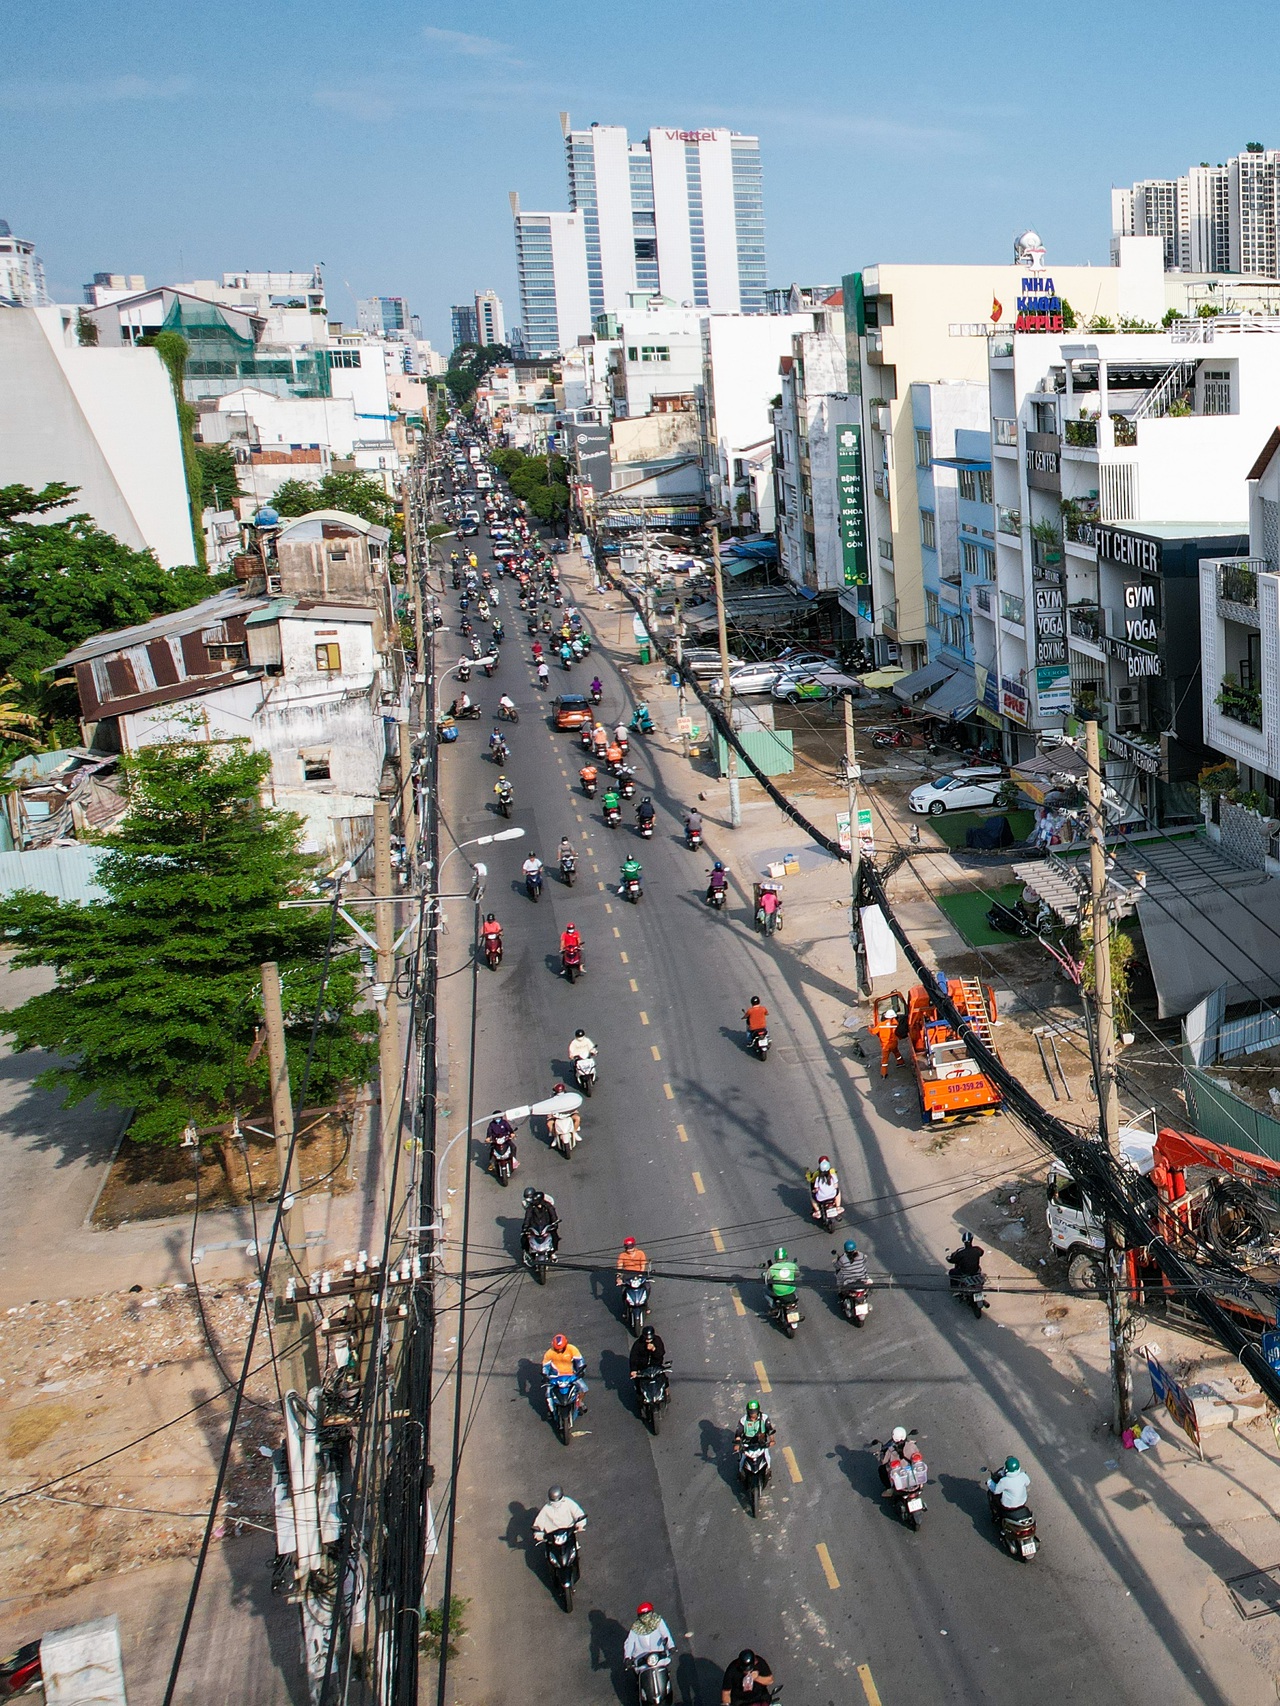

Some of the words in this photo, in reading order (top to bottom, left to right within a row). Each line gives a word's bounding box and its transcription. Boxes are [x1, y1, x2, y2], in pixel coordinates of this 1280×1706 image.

[665, 130, 717, 141] viettel
[1021, 277, 1056, 292] NHA
[1016, 296, 1061, 312] KHOA
[1015, 315, 1063, 331] APPLE
[1035, 450, 1057, 473] CENTER
[1095, 528, 1111, 558] FIT
[1113, 532, 1157, 572] CENTER
[1036, 591, 1063, 609] GYM
[1125, 586, 1155, 608] GYM
[1037, 617, 1064, 635] YOGA
[1126, 619, 1158, 641] YOGA
[1038, 642, 1065, 660] BOXING
[1127, 654, 1159, 677] BOXING
